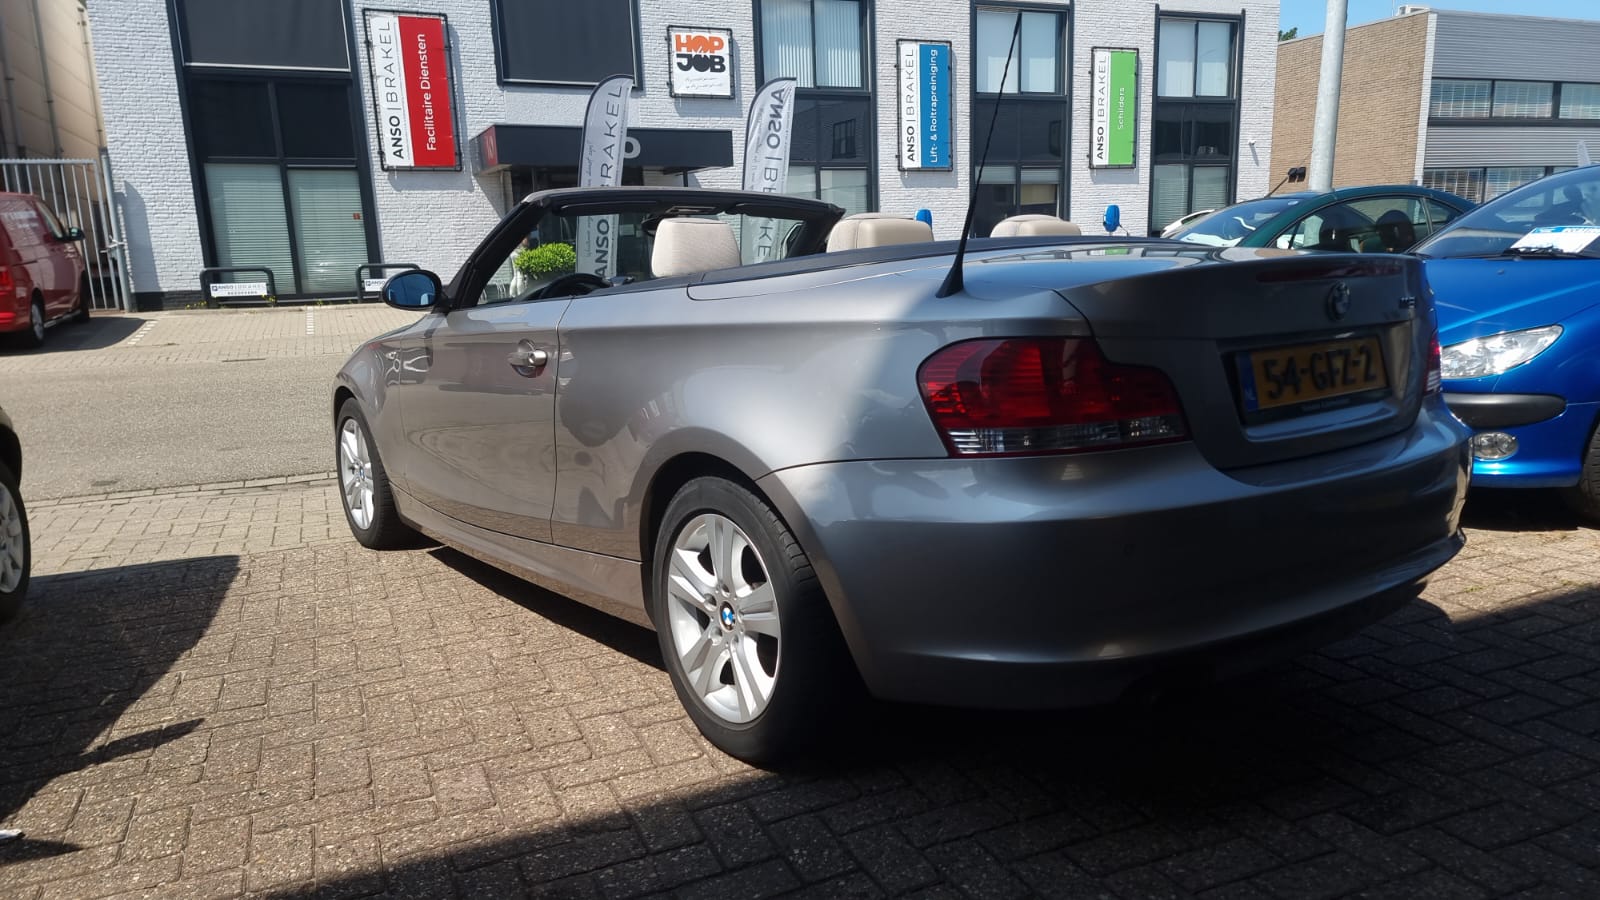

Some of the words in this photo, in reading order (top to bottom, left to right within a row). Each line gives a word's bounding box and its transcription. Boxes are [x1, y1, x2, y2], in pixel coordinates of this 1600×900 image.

[378, 21, 399, 103] BRAKEL
[417, 33, 431, 90] Diensten
[675, 34, 724, 53] HOP
[676, 53, 726, 73] JOB
[905, 48, 915, 116] BRAKEL
[929, 49, 938, 132] Roltrapreiniging
[1097, 55, 1106, 117] BRAKEL
[1117, 87, 1125, 130] Schilders
[389, 115, 404, 159] ANSO
[422, 92, 436, 150] Facilitaire
[600, 85, 622, 187] RAKEL
[906, 126, 915, 162] ANSO
[1096, 126, 1105, 160] ANSO
[930, 143, 938, 163] Lift-
[1264, 344, 1377, 399] 54-GFZ-2
